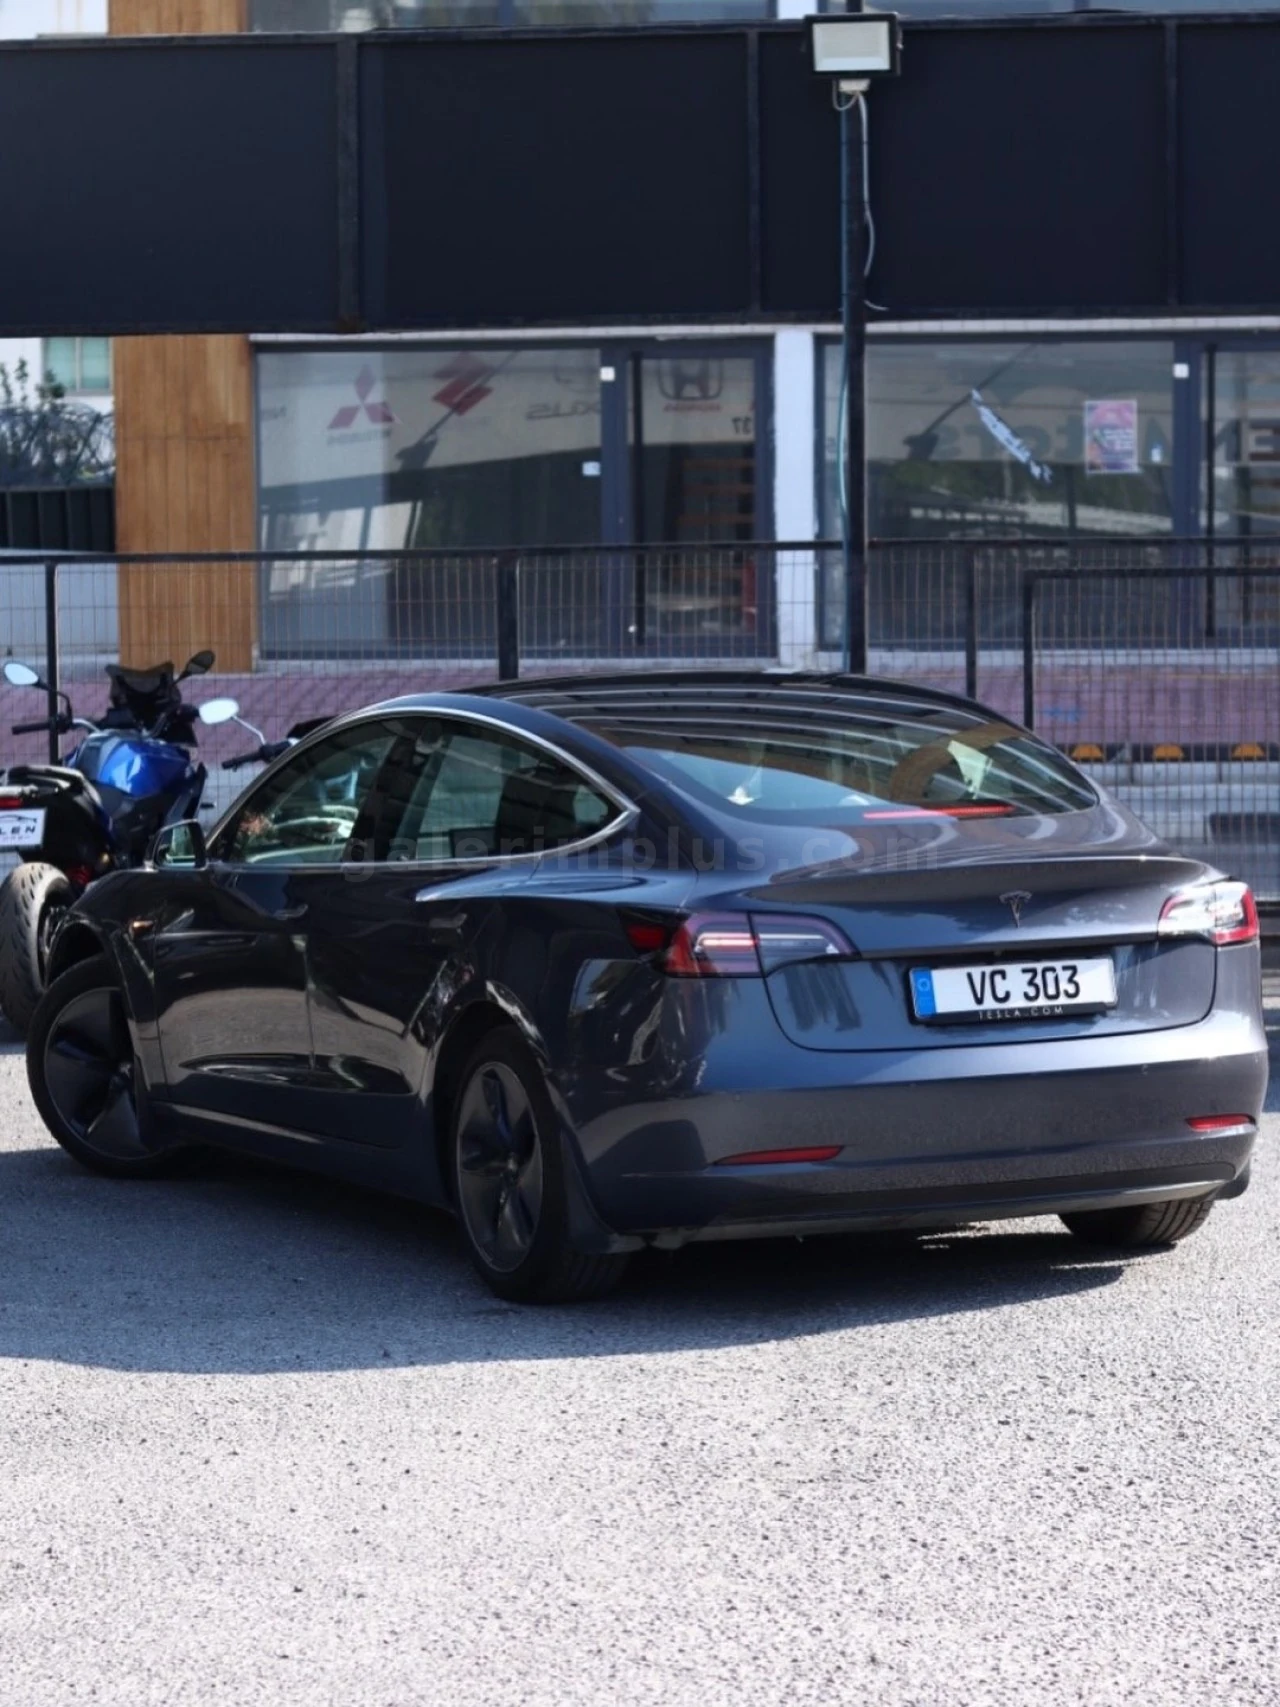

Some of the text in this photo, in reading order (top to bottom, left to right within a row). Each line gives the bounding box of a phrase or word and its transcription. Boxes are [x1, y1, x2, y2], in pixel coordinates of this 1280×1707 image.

[966, 965, 1080, 1005] VC 303
[978, 1006, 1063, 1020] TESLA.COM
